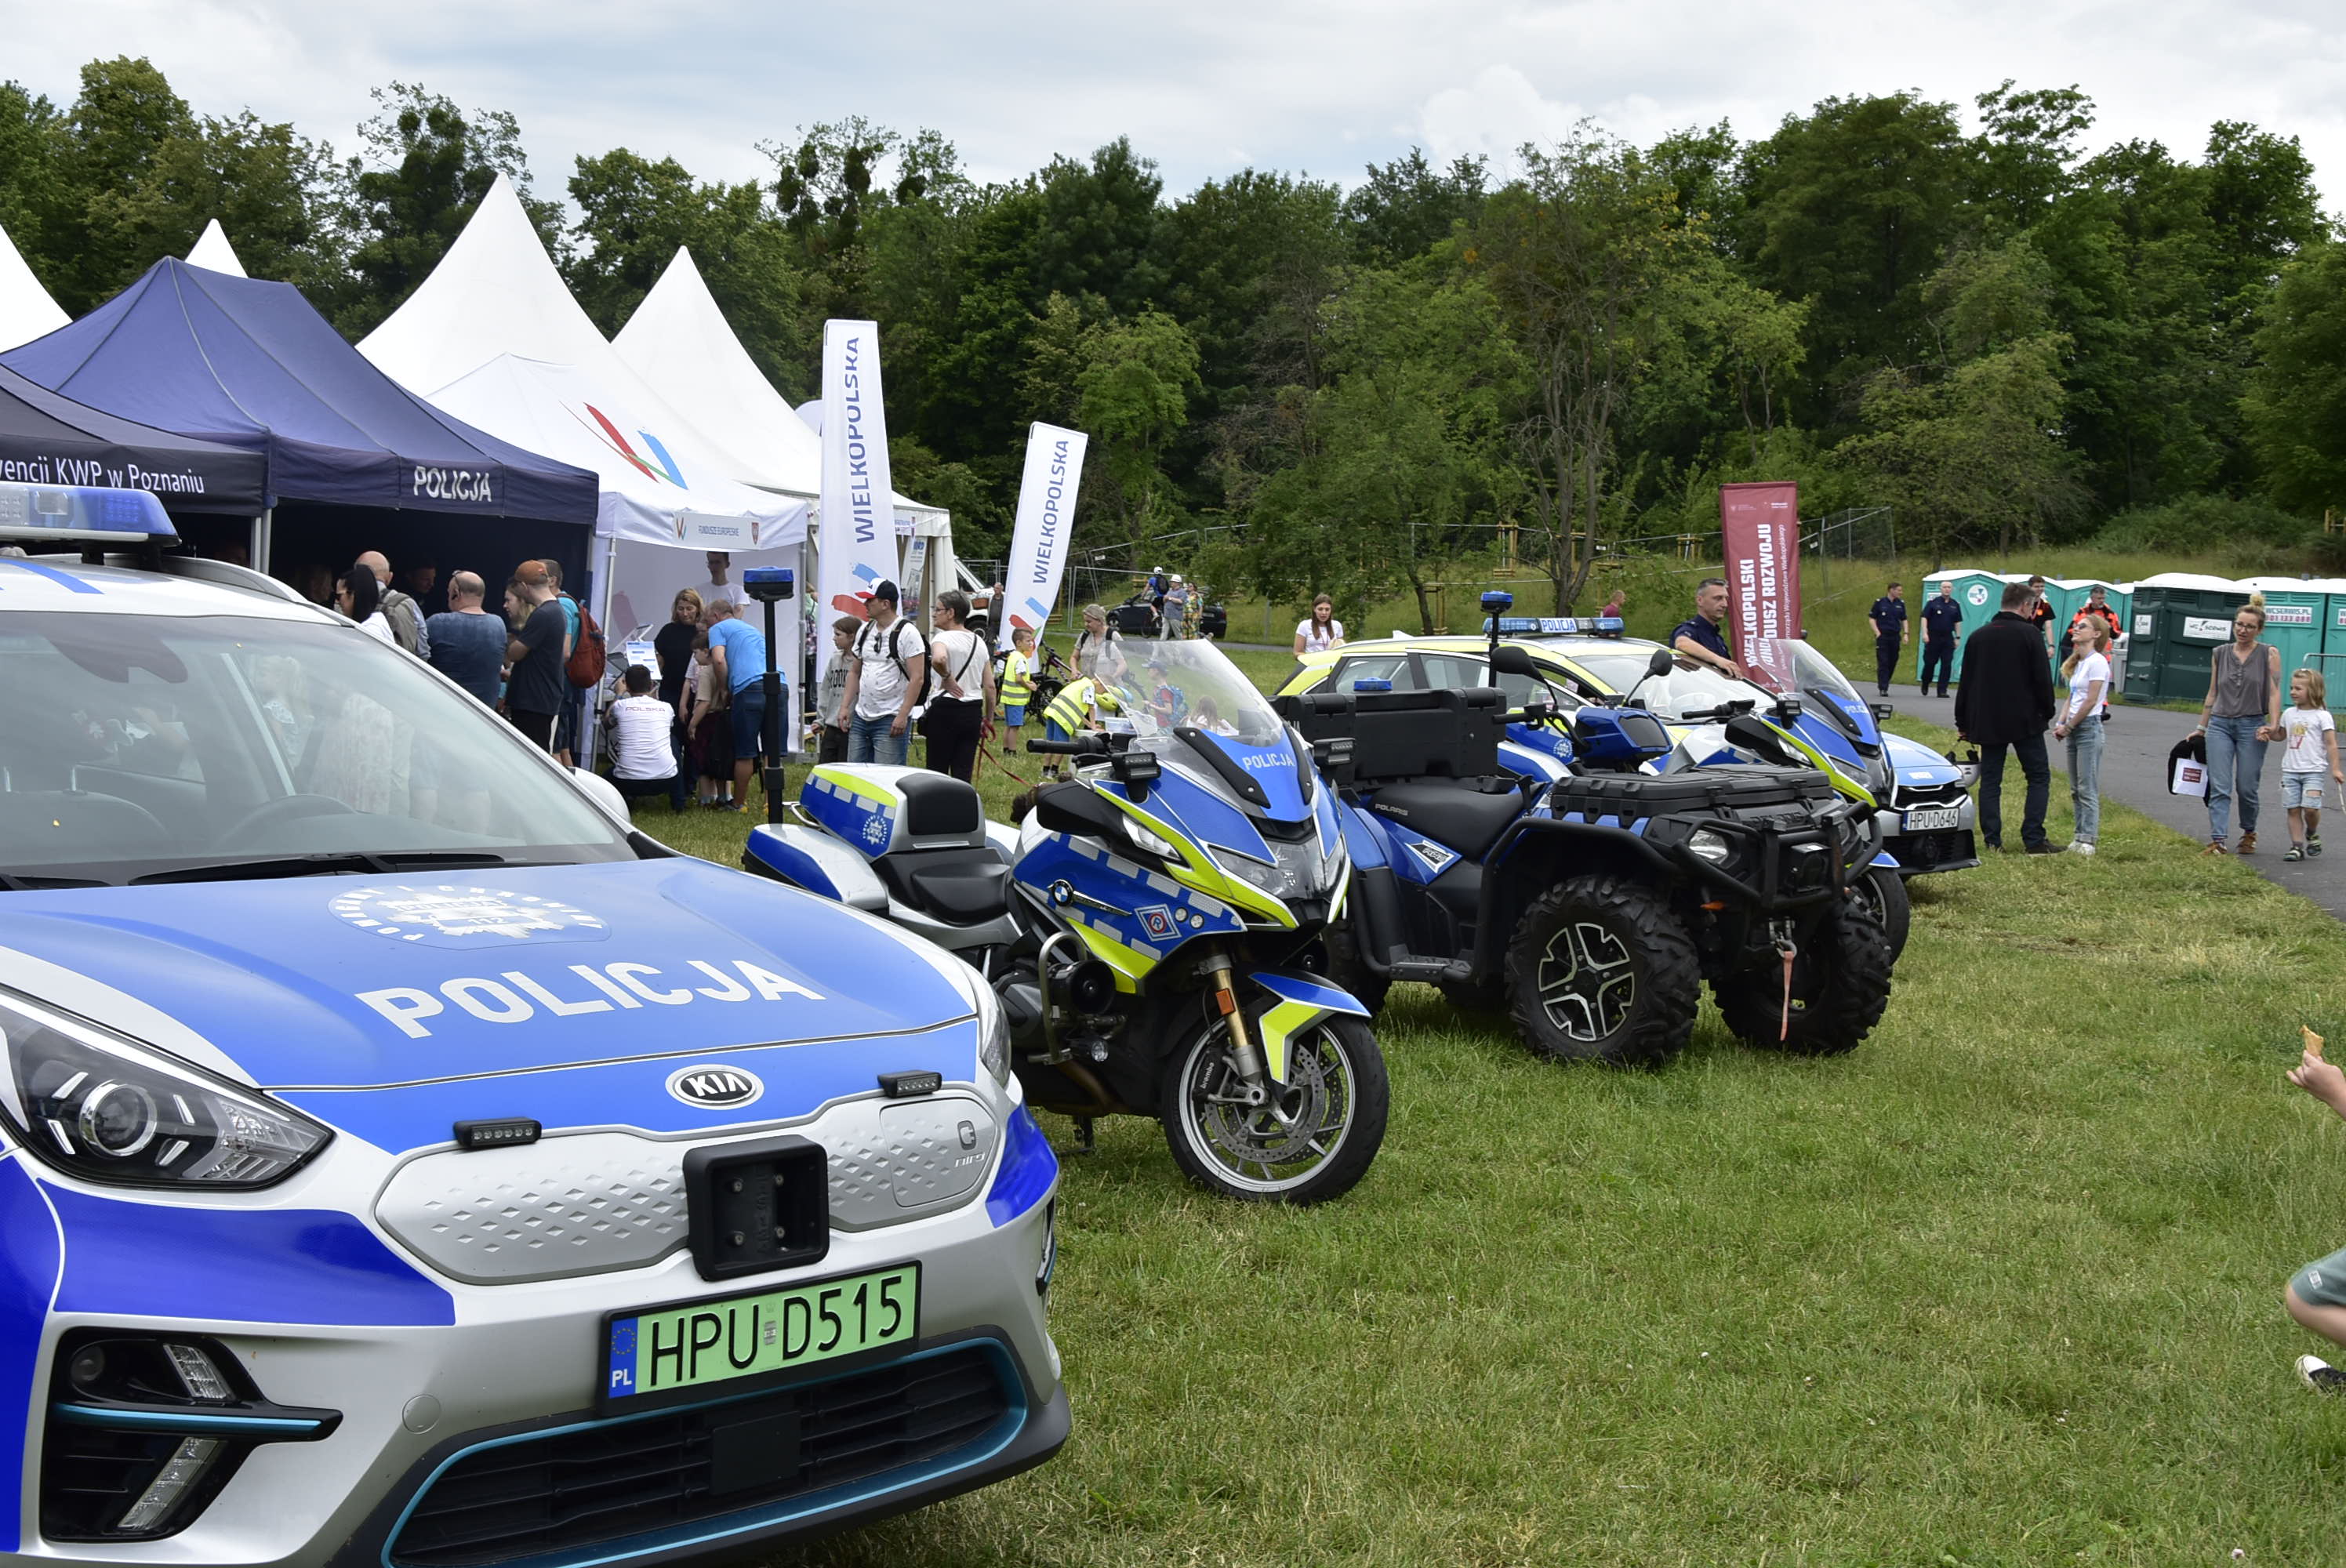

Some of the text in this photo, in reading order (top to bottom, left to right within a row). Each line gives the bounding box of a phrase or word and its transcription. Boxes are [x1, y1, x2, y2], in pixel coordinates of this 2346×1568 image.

[844, 337, 875, 543] WIELKOPOLSKA
[0, 456, 205, 494] encji KWP w Poznaniu
[413, 465, 492, 502] POLICJA
[1033, 441, 1070, 584] WIELKOPOLSKA
[1757, 524, 1777, 597] ROZWOJU
[1542, 619, 1576, 631] POLICJA
[1739, 559, 1759, 668] WIELKOPOLSKI
[1242, 753, 1295, 771] POLICJA
[1375, 804, 1408, 816] POLARIS
[1910, 809, 1956, 829] HPU D646
[354, 960, 827, 1039] POLICJA
[686, 1073, 749, 1097] KIA
[1200, 1062, 1215, 1089] brembo
[611, 1276, 902, 1388] PL HPU D515
